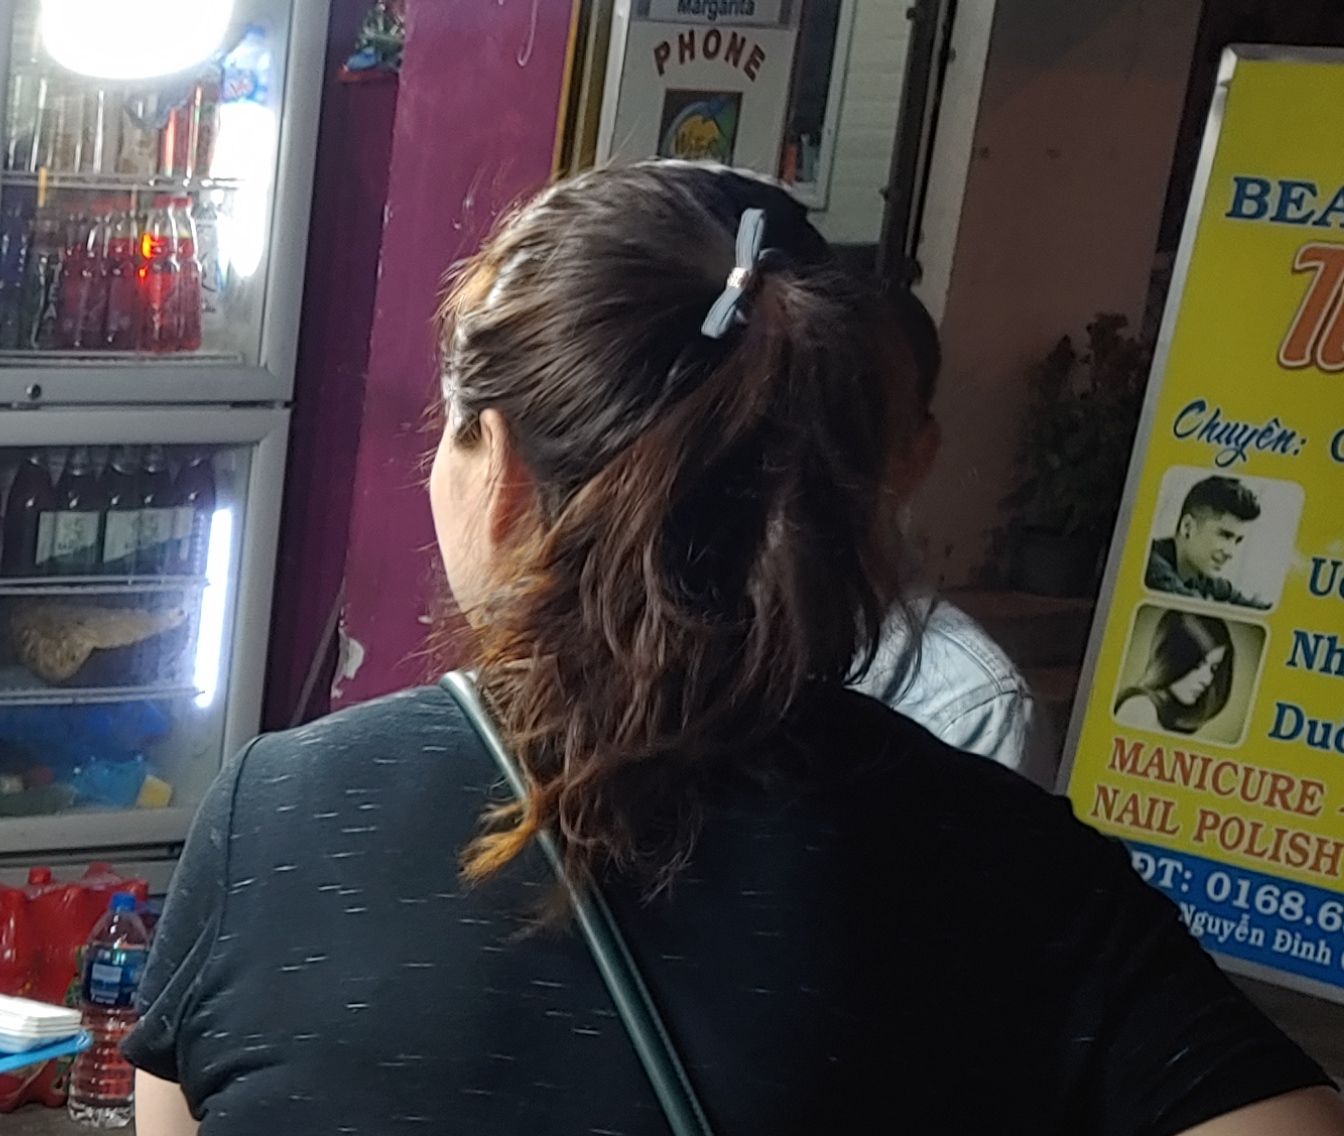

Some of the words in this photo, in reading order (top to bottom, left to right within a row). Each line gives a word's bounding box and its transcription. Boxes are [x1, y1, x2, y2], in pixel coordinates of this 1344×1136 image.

[654, 28, 766, 82] PHONE
[1173, 400, 1307, 468] Chuyên:
[1108, 737, 1325, 818] MANICURE
[1090, 783, 1180, 836] NAIL
[1192, 807, 1344, 878] POLISH
[1178, 902, 1266, 948] Nguyễn
[1272, 926, 1332, 967] Đình
[1206, 871, 1344, 933] 0168.6
